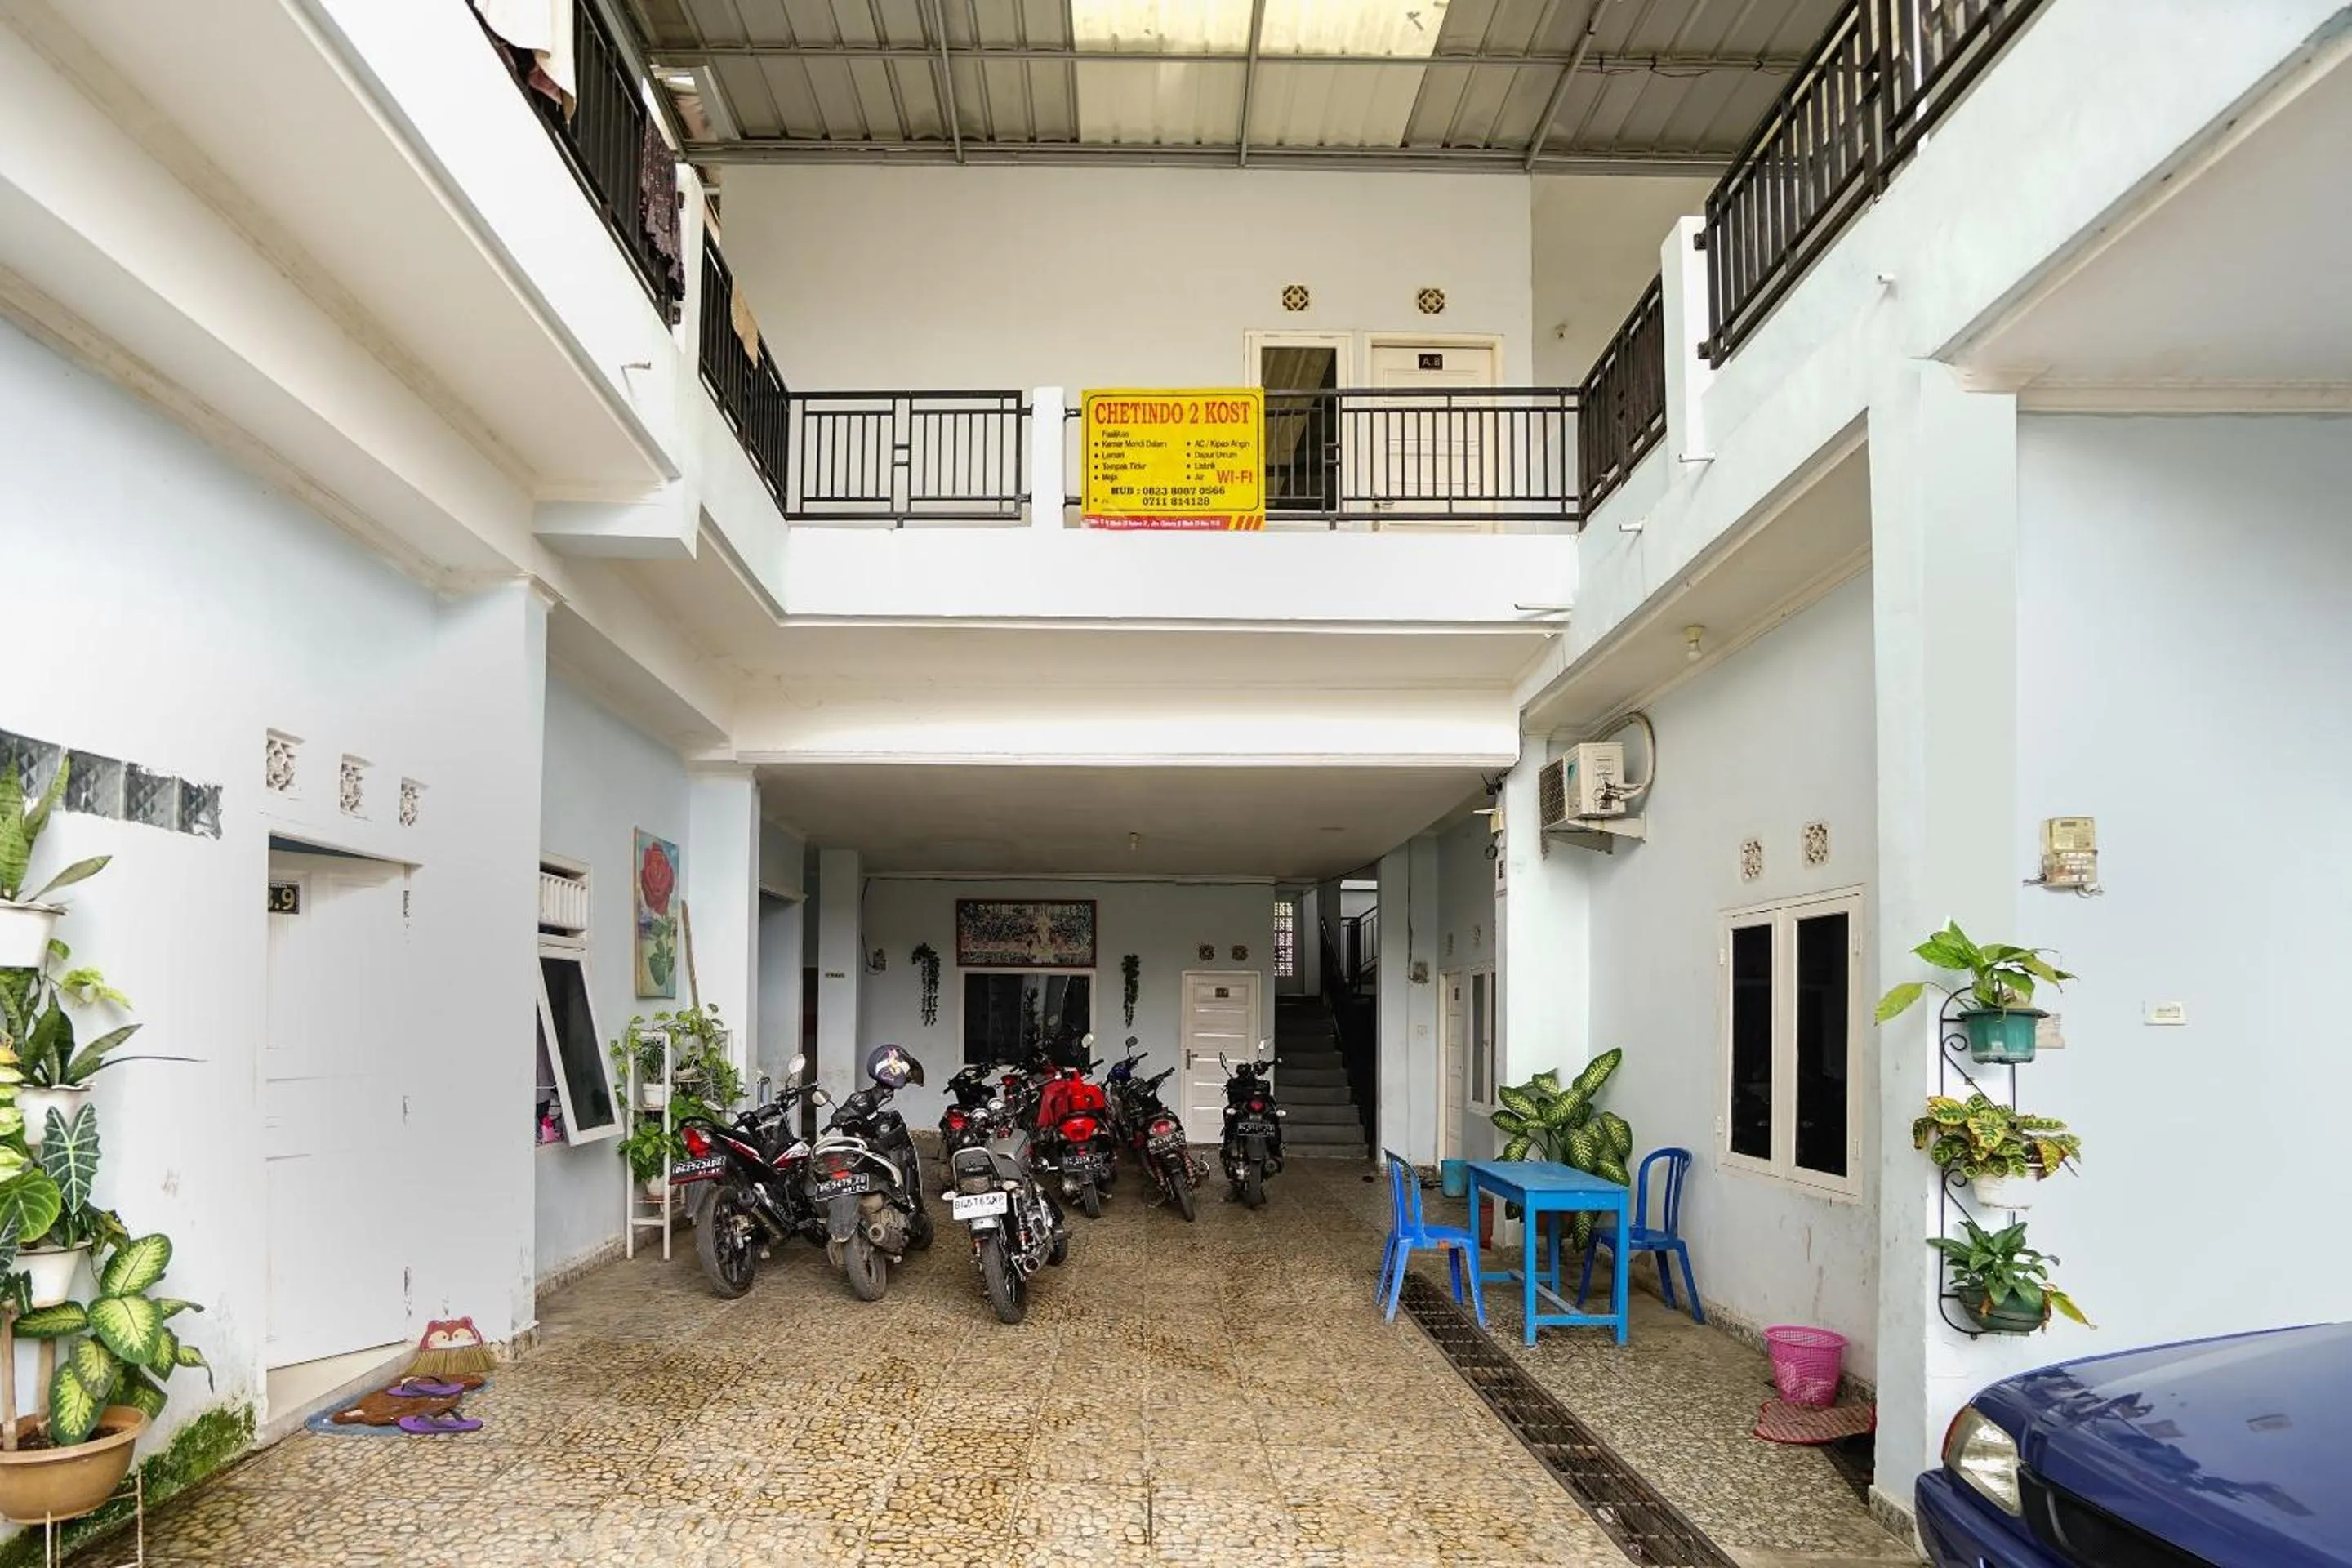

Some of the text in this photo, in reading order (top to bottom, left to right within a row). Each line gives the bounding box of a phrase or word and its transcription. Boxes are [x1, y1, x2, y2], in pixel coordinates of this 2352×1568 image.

[1095, 401, 1250, 425] CHETINDO 2 KOST
[1194, 439, 1205, 448] AC
[1209, 439, 1229, 449] Kipas
[1231, 439, 1250, 449] Angin
[1215, 451, 1238, 459] Umum
[1102, 462, 1147, 471] Tempat Tidur
[1194, 473, 1205, 481] Air
[1216, 470, 1253, 484] WI-FI
[1111, 487, 1134, 495] HUB
[1143, 497, 1167, 506] 0711
